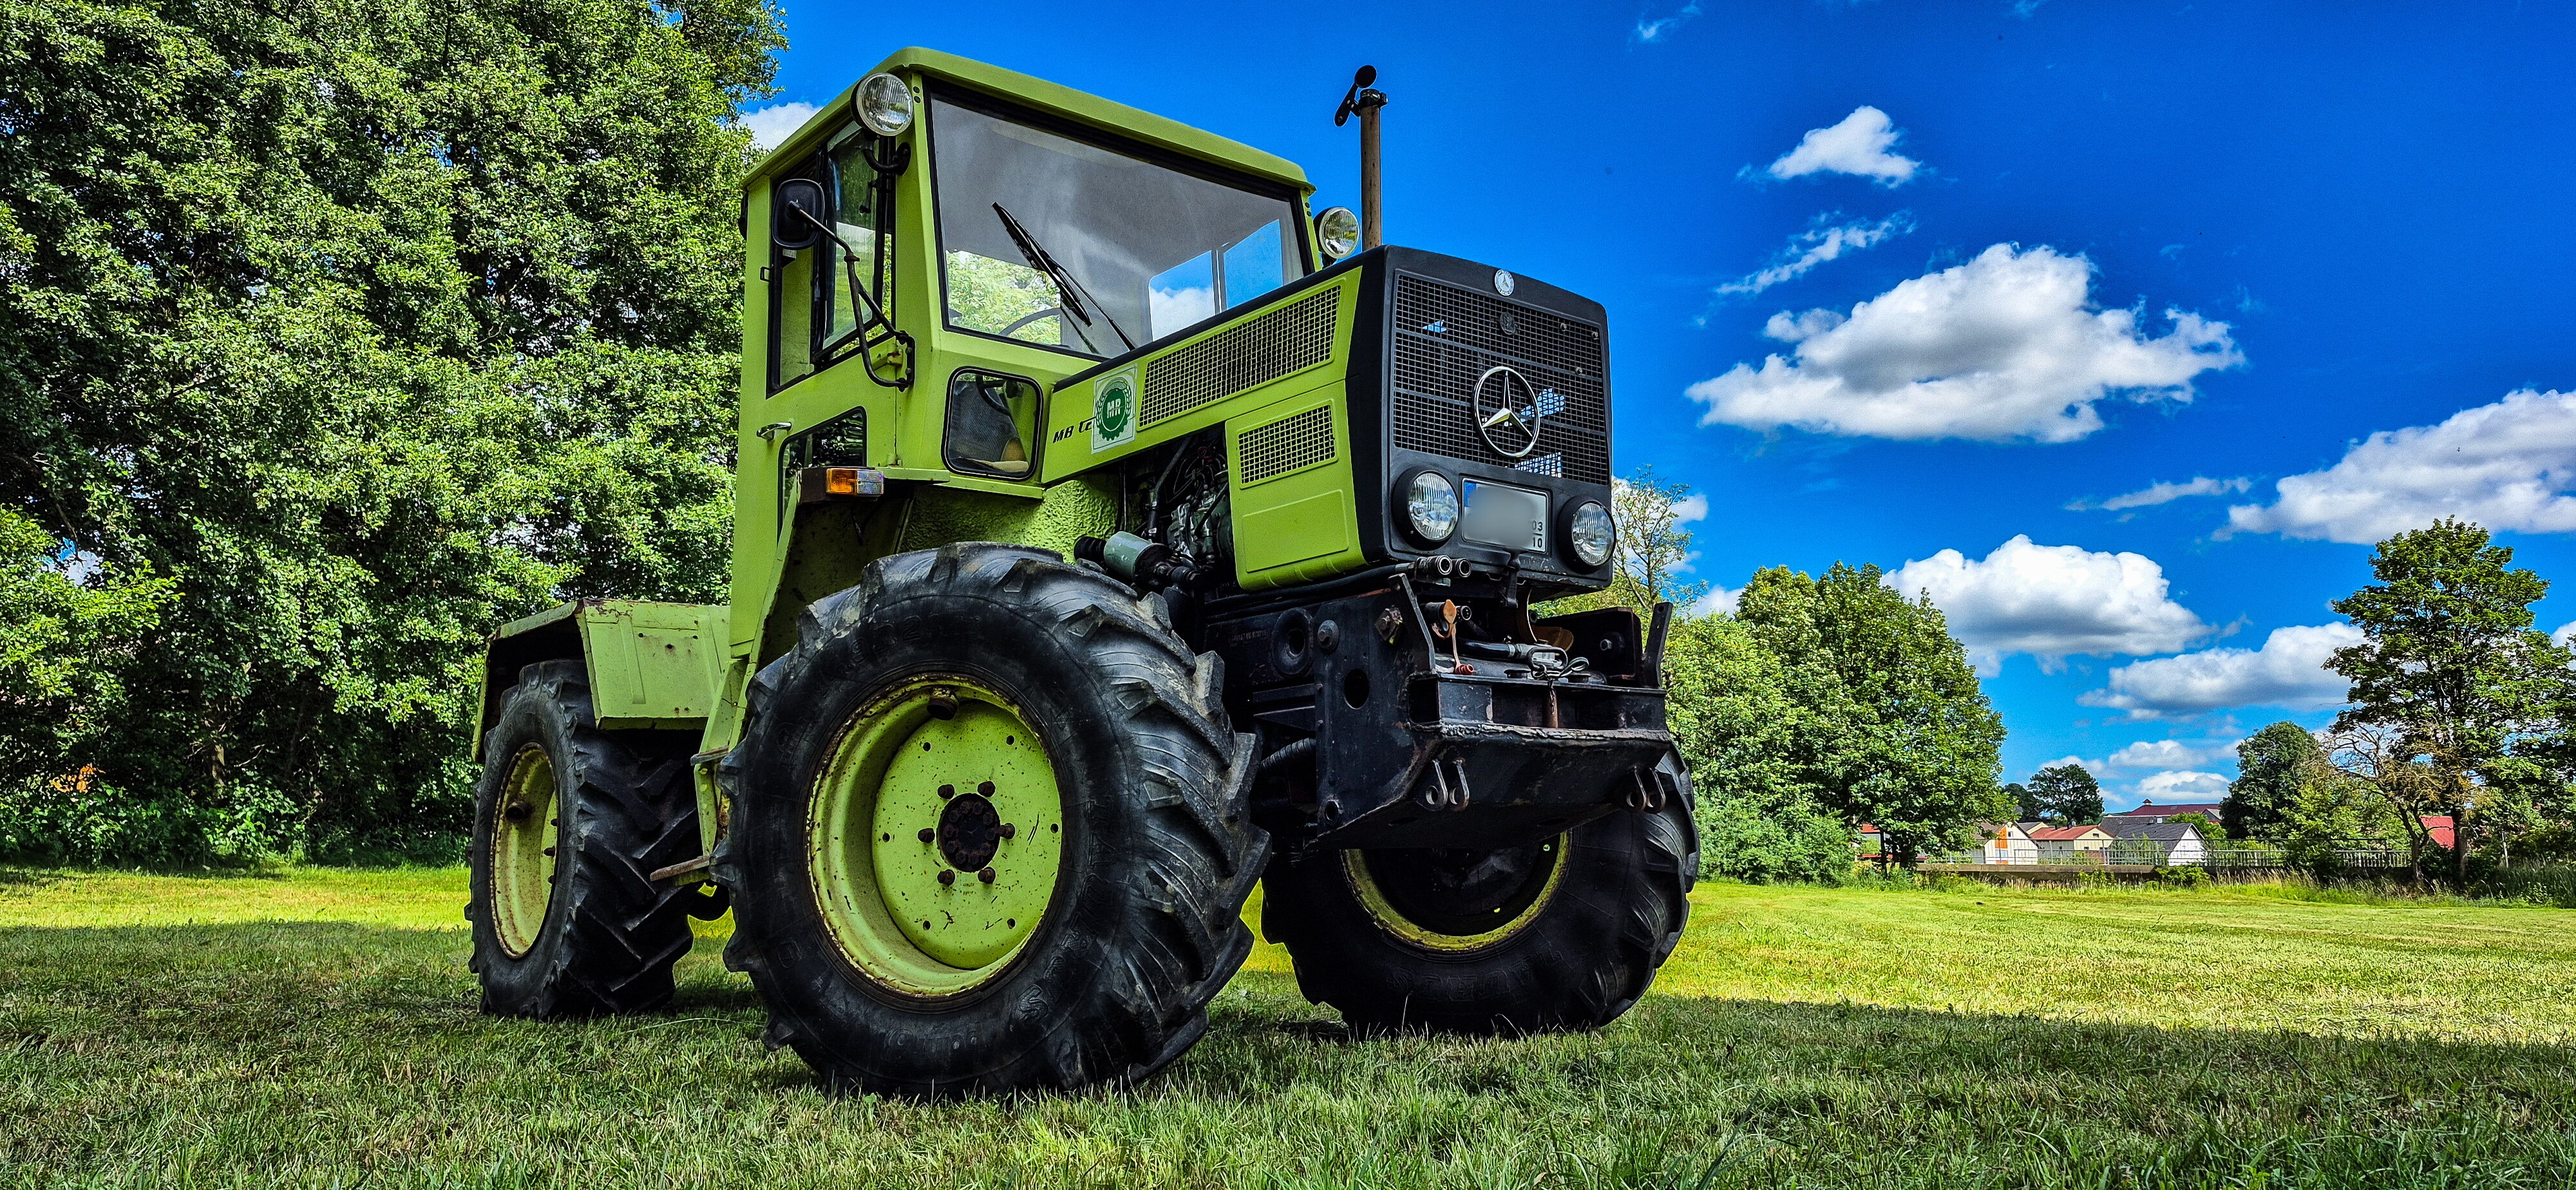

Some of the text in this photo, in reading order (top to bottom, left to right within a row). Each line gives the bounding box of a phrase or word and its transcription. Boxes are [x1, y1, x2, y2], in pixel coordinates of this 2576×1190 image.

[1107, 399, 1121, 419] MR
[1053, 426, 1074, 443] MB
[1532, 520, 1543, 531] 03
[1533, 537, 1542, 548] 10
